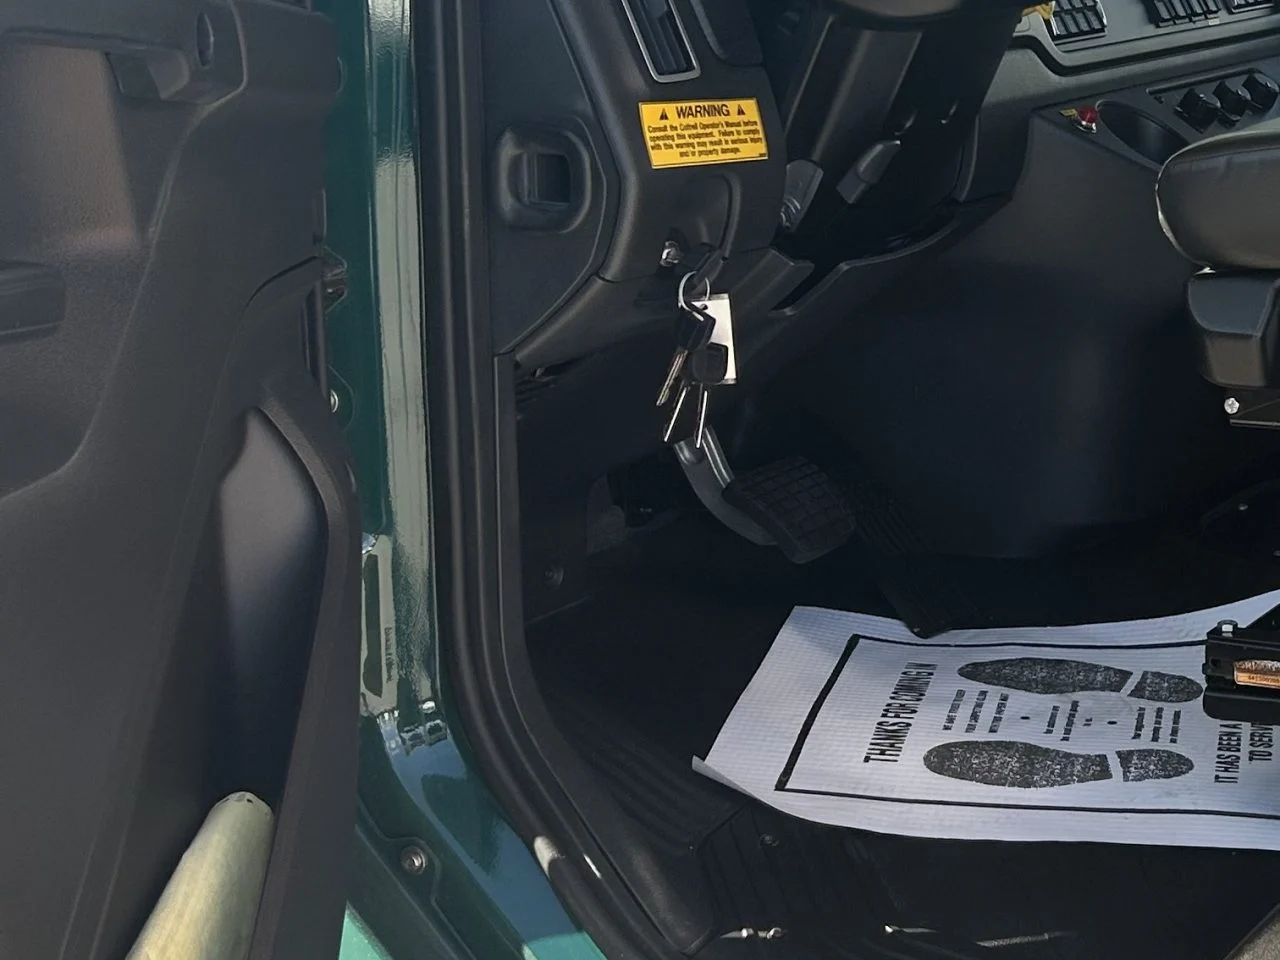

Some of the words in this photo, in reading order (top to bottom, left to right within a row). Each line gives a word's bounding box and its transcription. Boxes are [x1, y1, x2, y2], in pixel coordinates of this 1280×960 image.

[676, 104, 730, 119] WARNING
[669, 124, 678, 132] the
[676, 132, 686, 140] this
[651, 143, 662, 151] with
[675, 141, 696, 149] warning
[697, 140, 708, 148] may
[697, 148, 719, 156] property
[904, 661, 938, 670] IN
[889, 671, 934, 701] COMING
[880, 703, 920, 719] FOR
[863, 720, 912, 763] THANKS
[1217, 731, 1242, 753] BEEN
[1248, 750, 1273, 761] TO
[1215, 754, 1241, 773] HAS
[1214, 774, 1239, 783] IT
